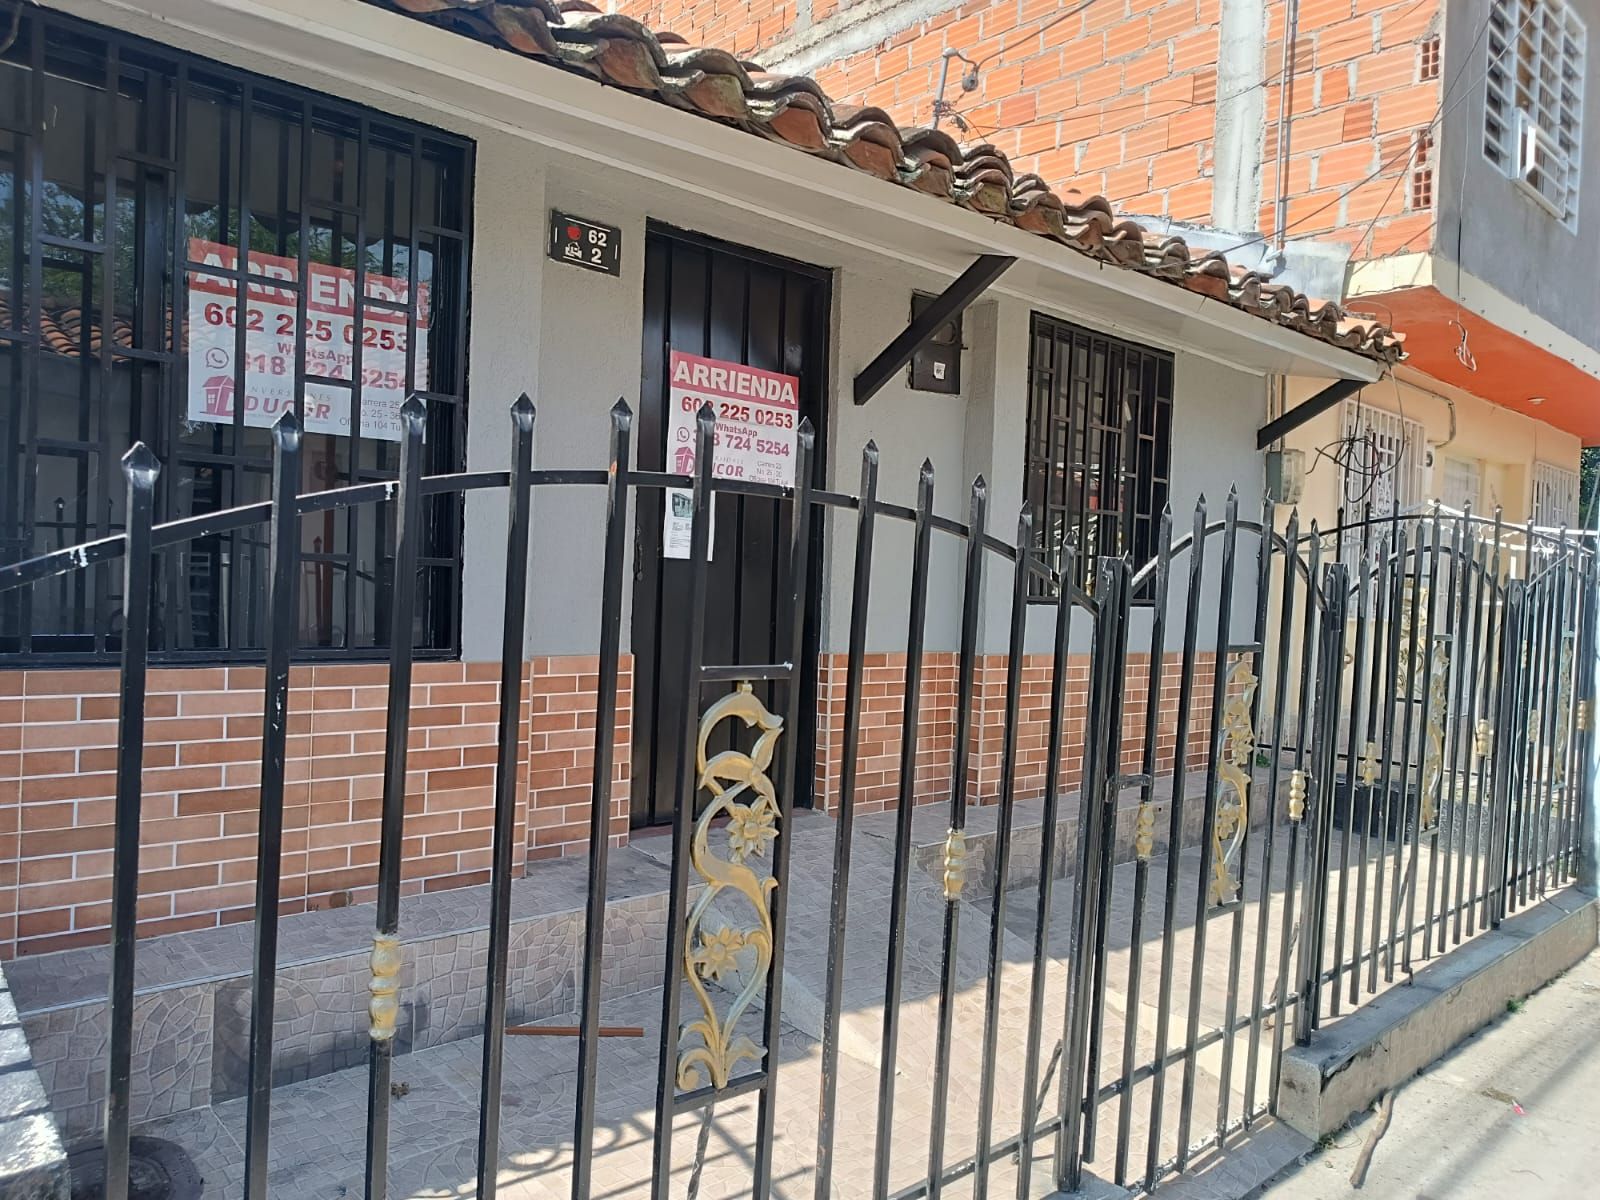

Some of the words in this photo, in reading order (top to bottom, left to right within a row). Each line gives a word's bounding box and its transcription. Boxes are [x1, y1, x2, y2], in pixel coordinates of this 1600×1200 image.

[588, 230, 607, 247] 62
[591, 248, 602, 264] 2
[196, 253, 424, 321] ARRENDA
[673, 360, 796, 405] ARRIENDA
[371, 409, 383, 418] 25
[720, 403, 750, 422] 225
[755, 409, 794, 429] 0253
[714, 422, 758, 438] WhatsApp
[725, 434, 752, 451] 724
[756, 439, 790, 457] 5254
